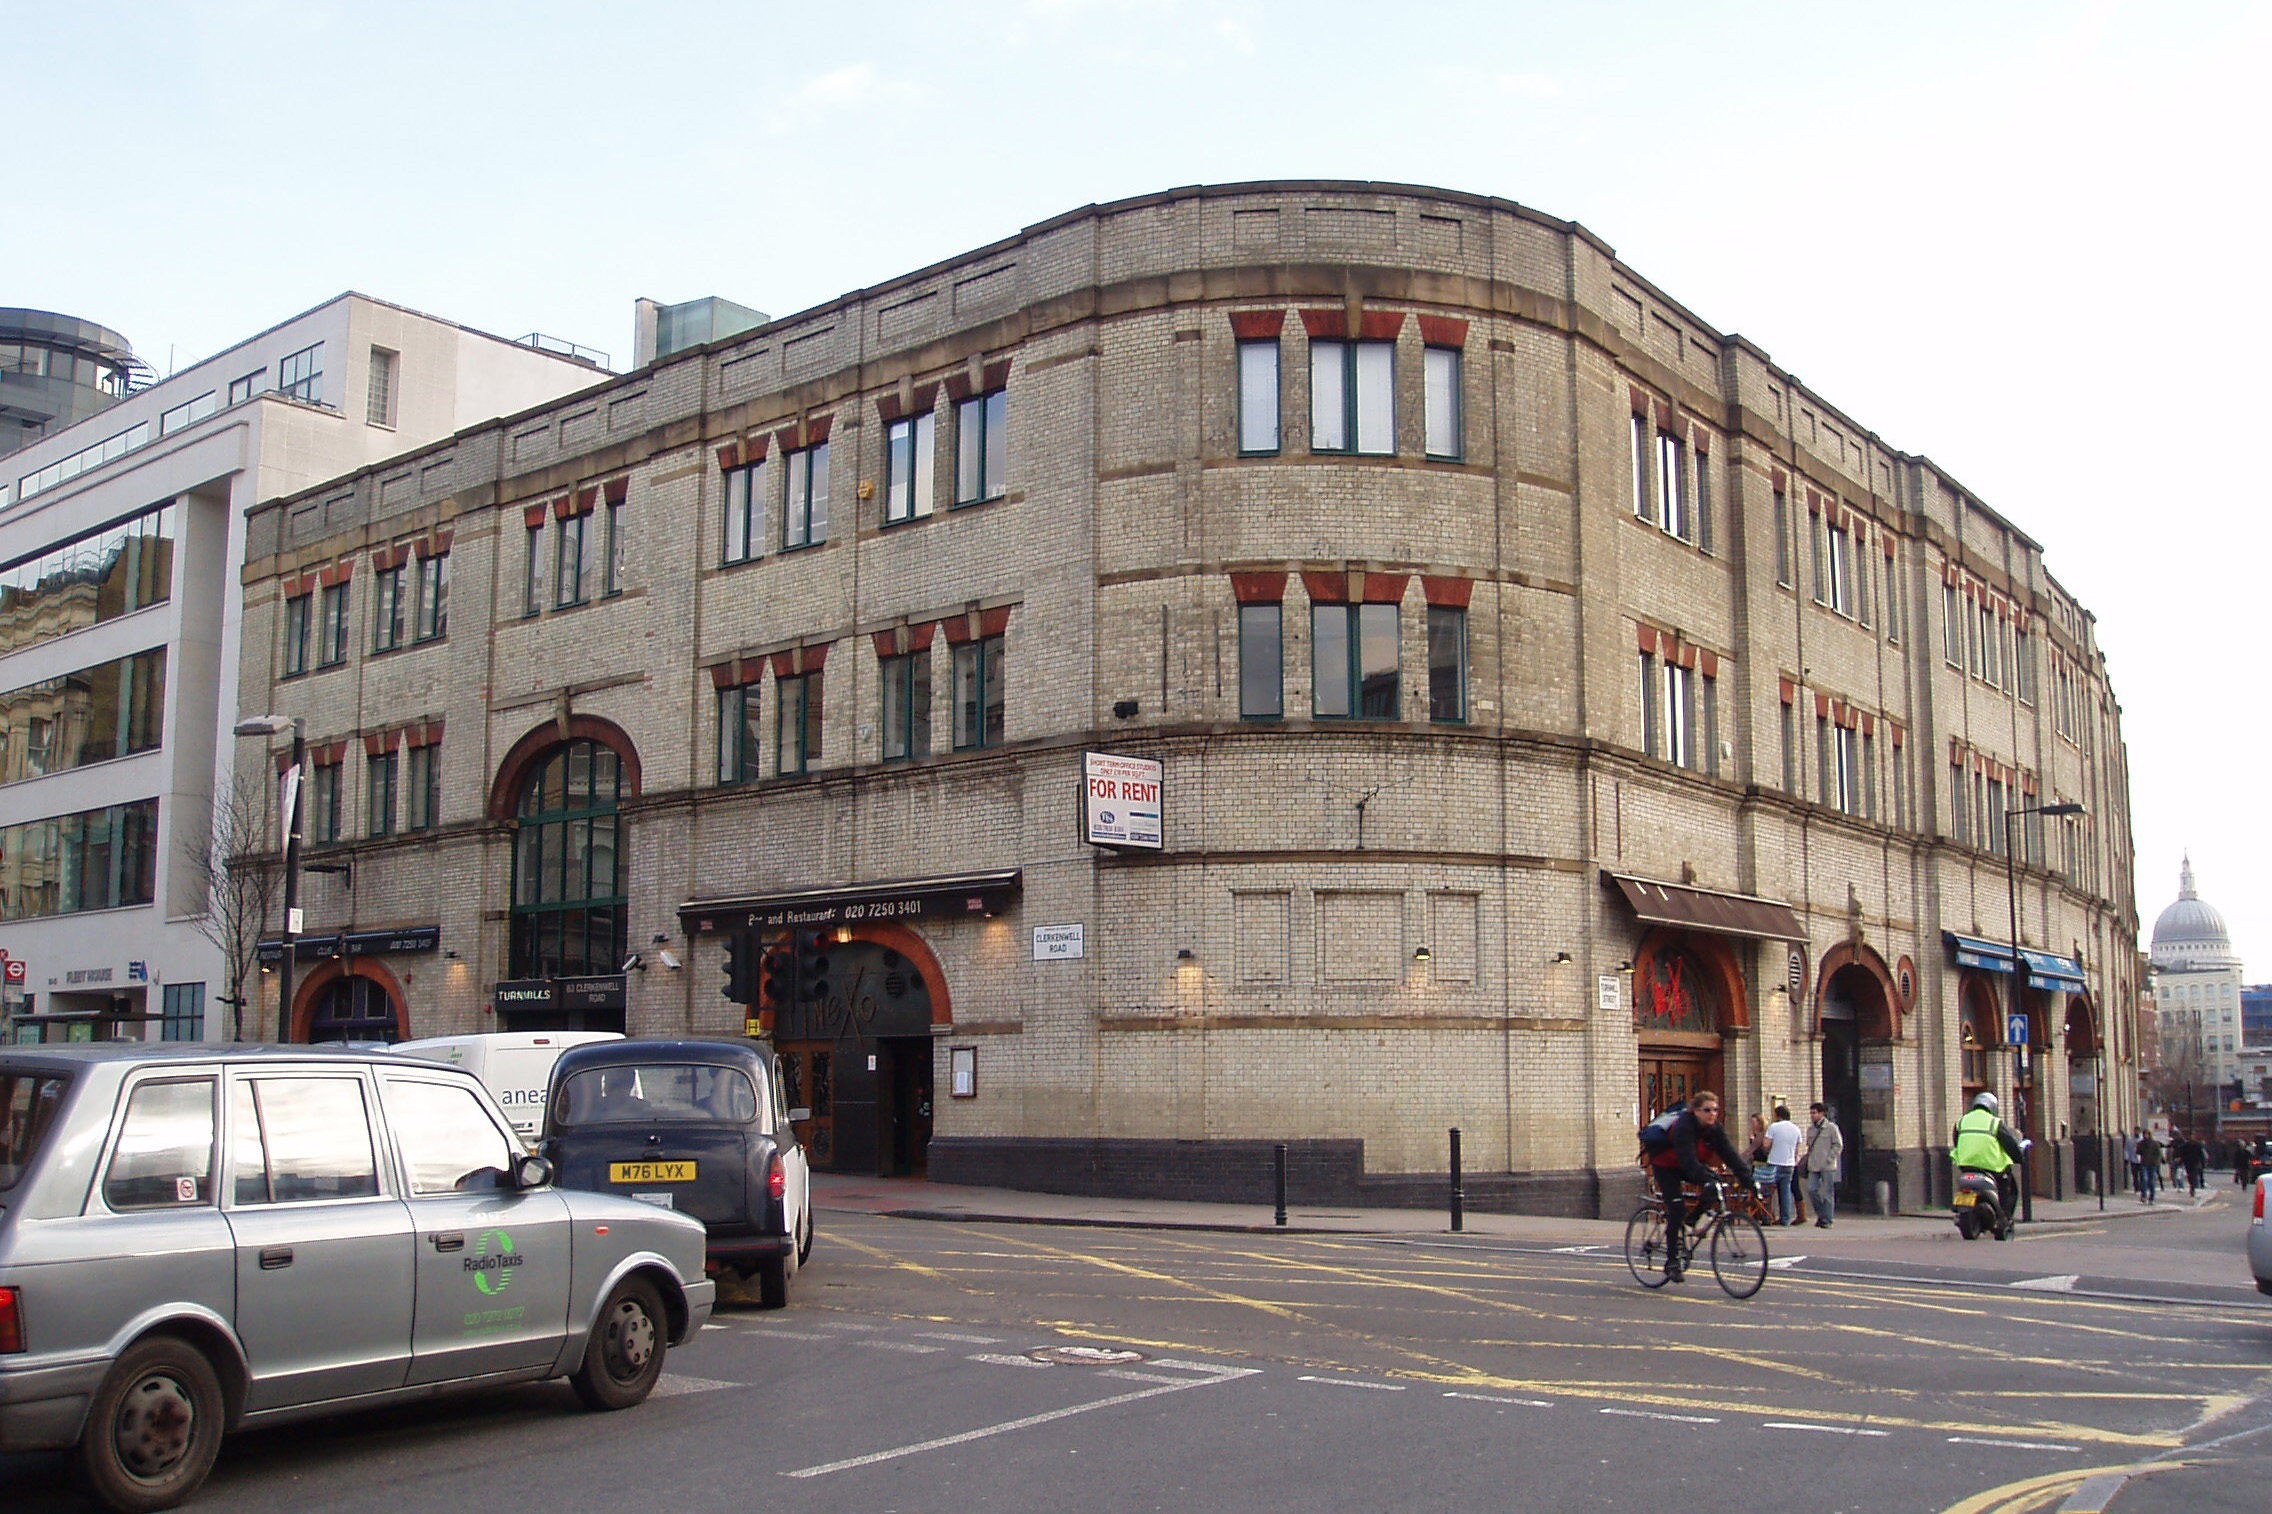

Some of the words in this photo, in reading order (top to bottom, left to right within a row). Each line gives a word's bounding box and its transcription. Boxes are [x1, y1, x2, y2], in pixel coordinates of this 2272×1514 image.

[1089, 778, 1117, 799] FOR
[1122, 781, 1158, 802] RENT
[767, 912, 783, 925] and
[845, 905, 865, 919] 020
[868, 902, 895, 918] 7250
[898, 900, 921, 915] 3401
[1050, 943, 1067, 952] ROAD
[498, 989, 551, 1000] TURNMILLS
[622, 1165, 651, 1179] M76
[655, 1164, 684, 1178] LYX
